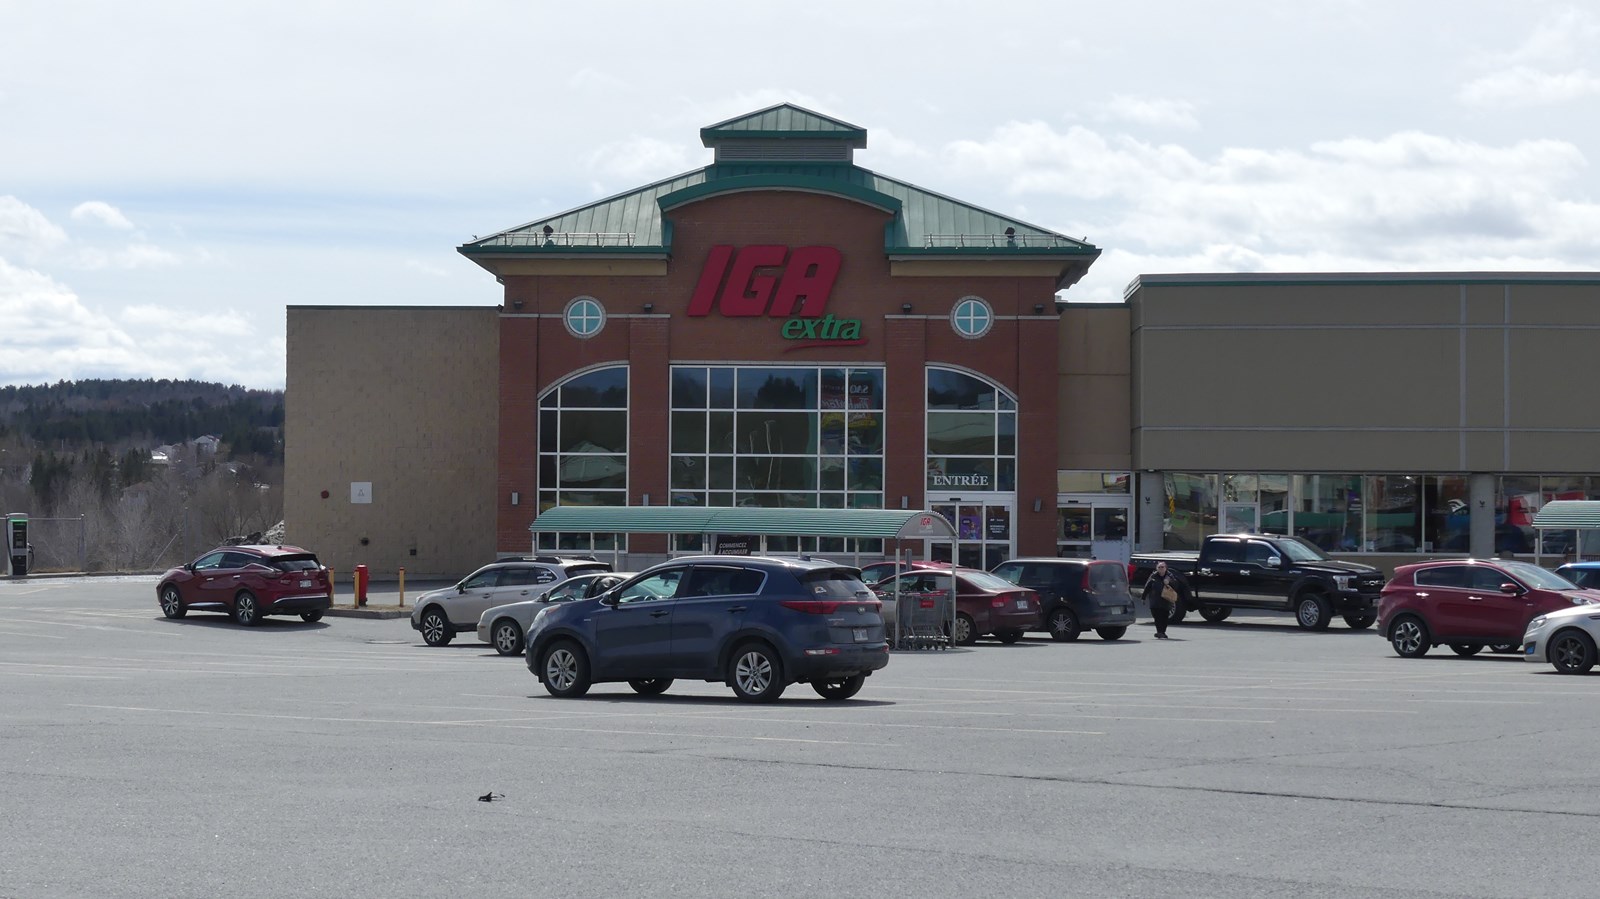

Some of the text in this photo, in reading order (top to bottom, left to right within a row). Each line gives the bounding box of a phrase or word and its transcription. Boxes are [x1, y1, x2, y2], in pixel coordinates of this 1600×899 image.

[688, 245, 841, 316] IGA
[782, 314, 861, 339] extra
[933, 474, 989, 485] ENTRÉE
